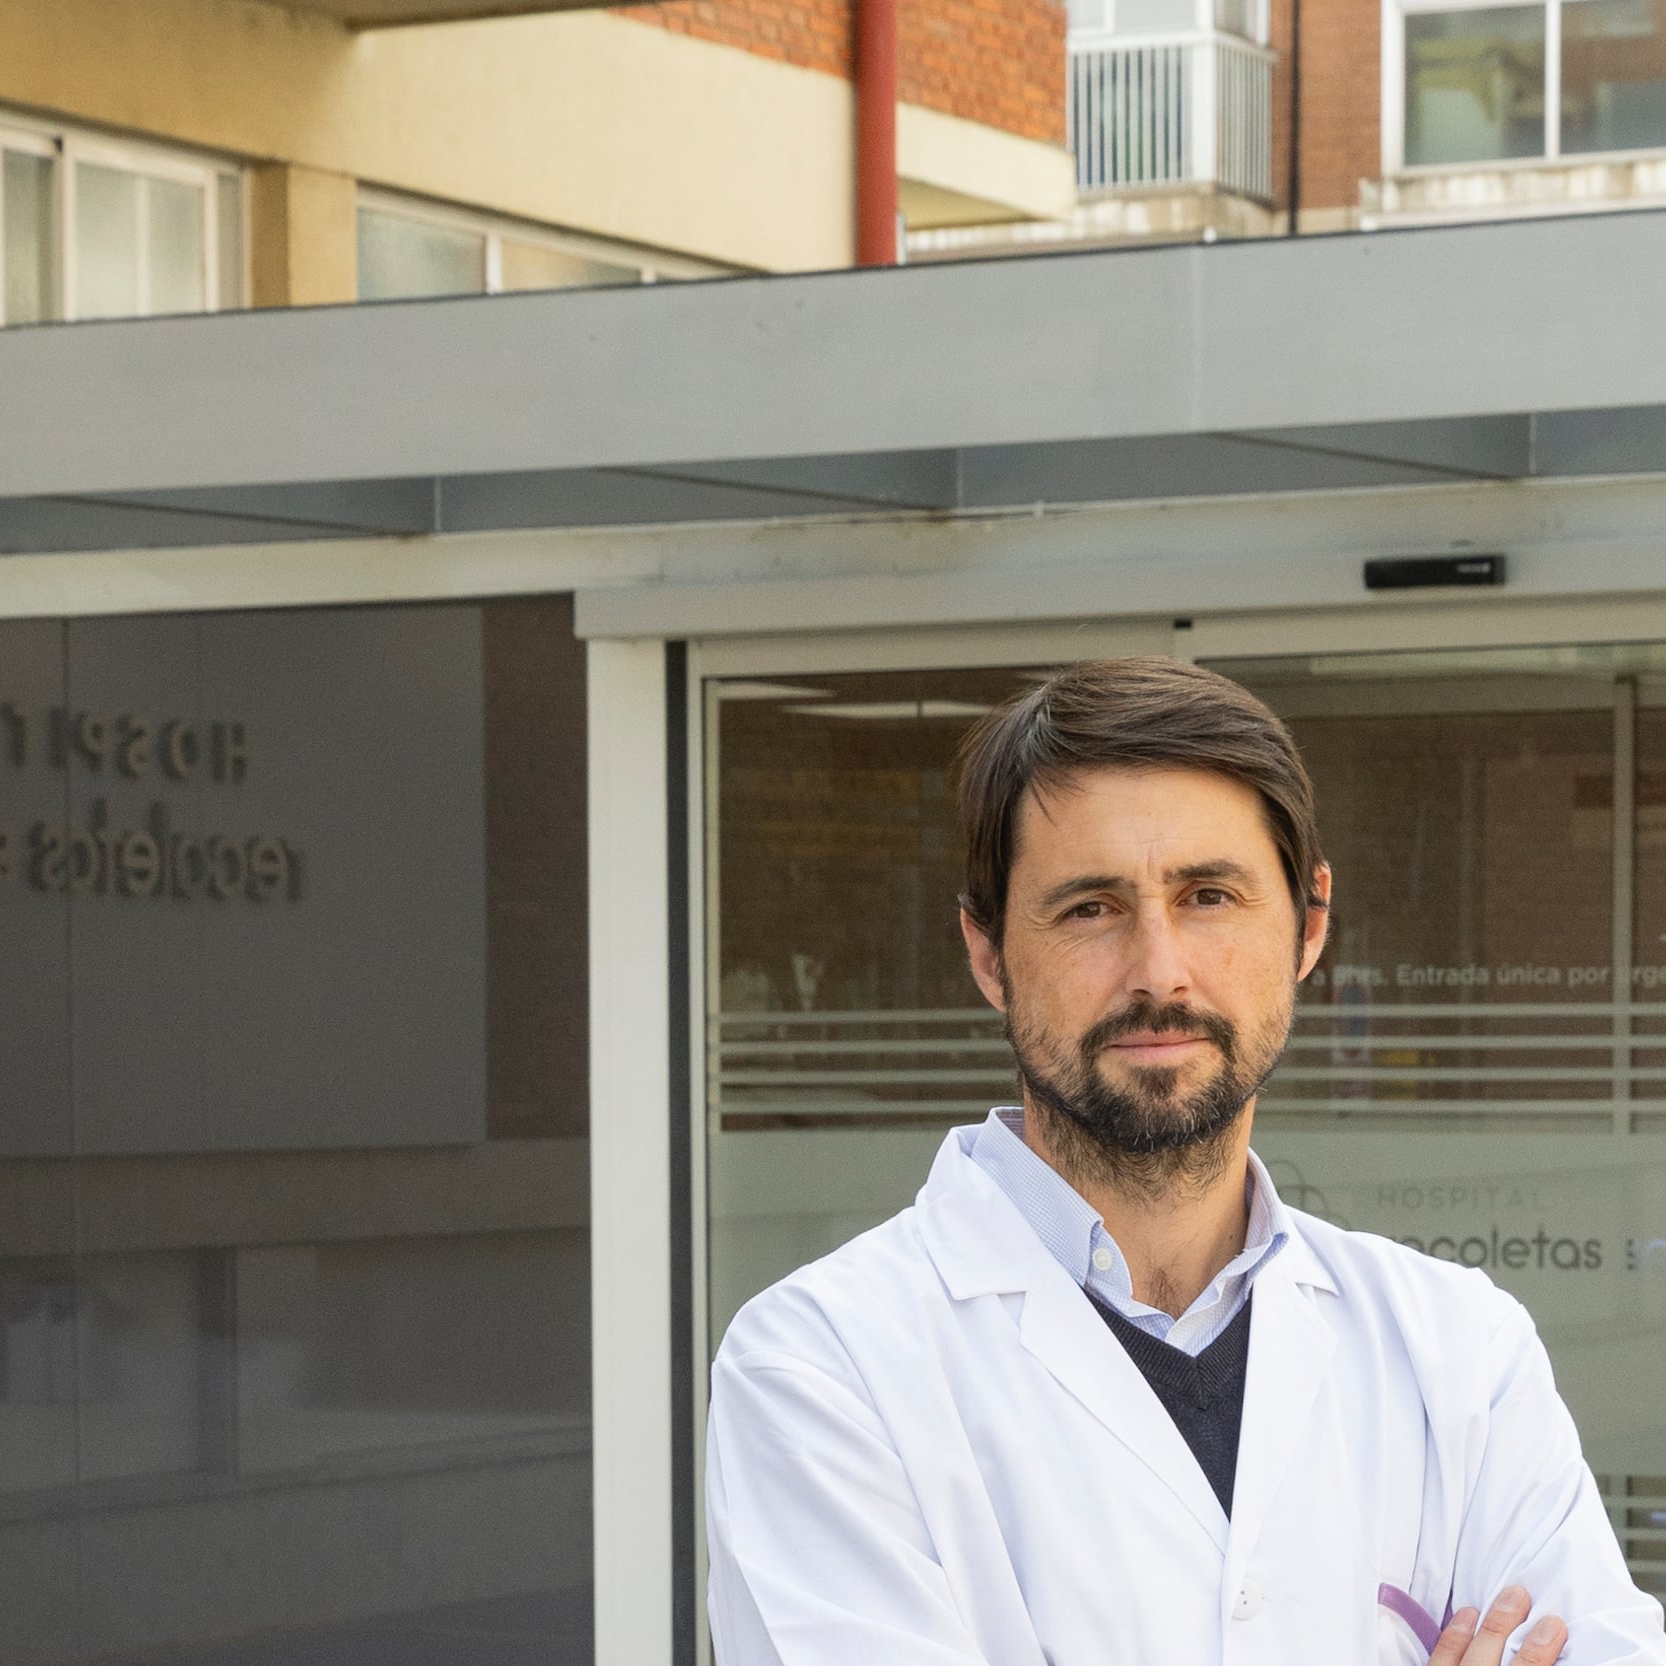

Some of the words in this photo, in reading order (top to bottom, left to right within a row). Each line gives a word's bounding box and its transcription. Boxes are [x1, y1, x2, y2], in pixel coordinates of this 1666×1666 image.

[1396, 963, 1490, 986] Entrada
[1497, 962, 1561, 986] única
[1568, 966, 1610, 989] por
[1377, 1185, 1547, 1211] HOSPITAL
[1390, 1223, 1603, 1270] coletas
